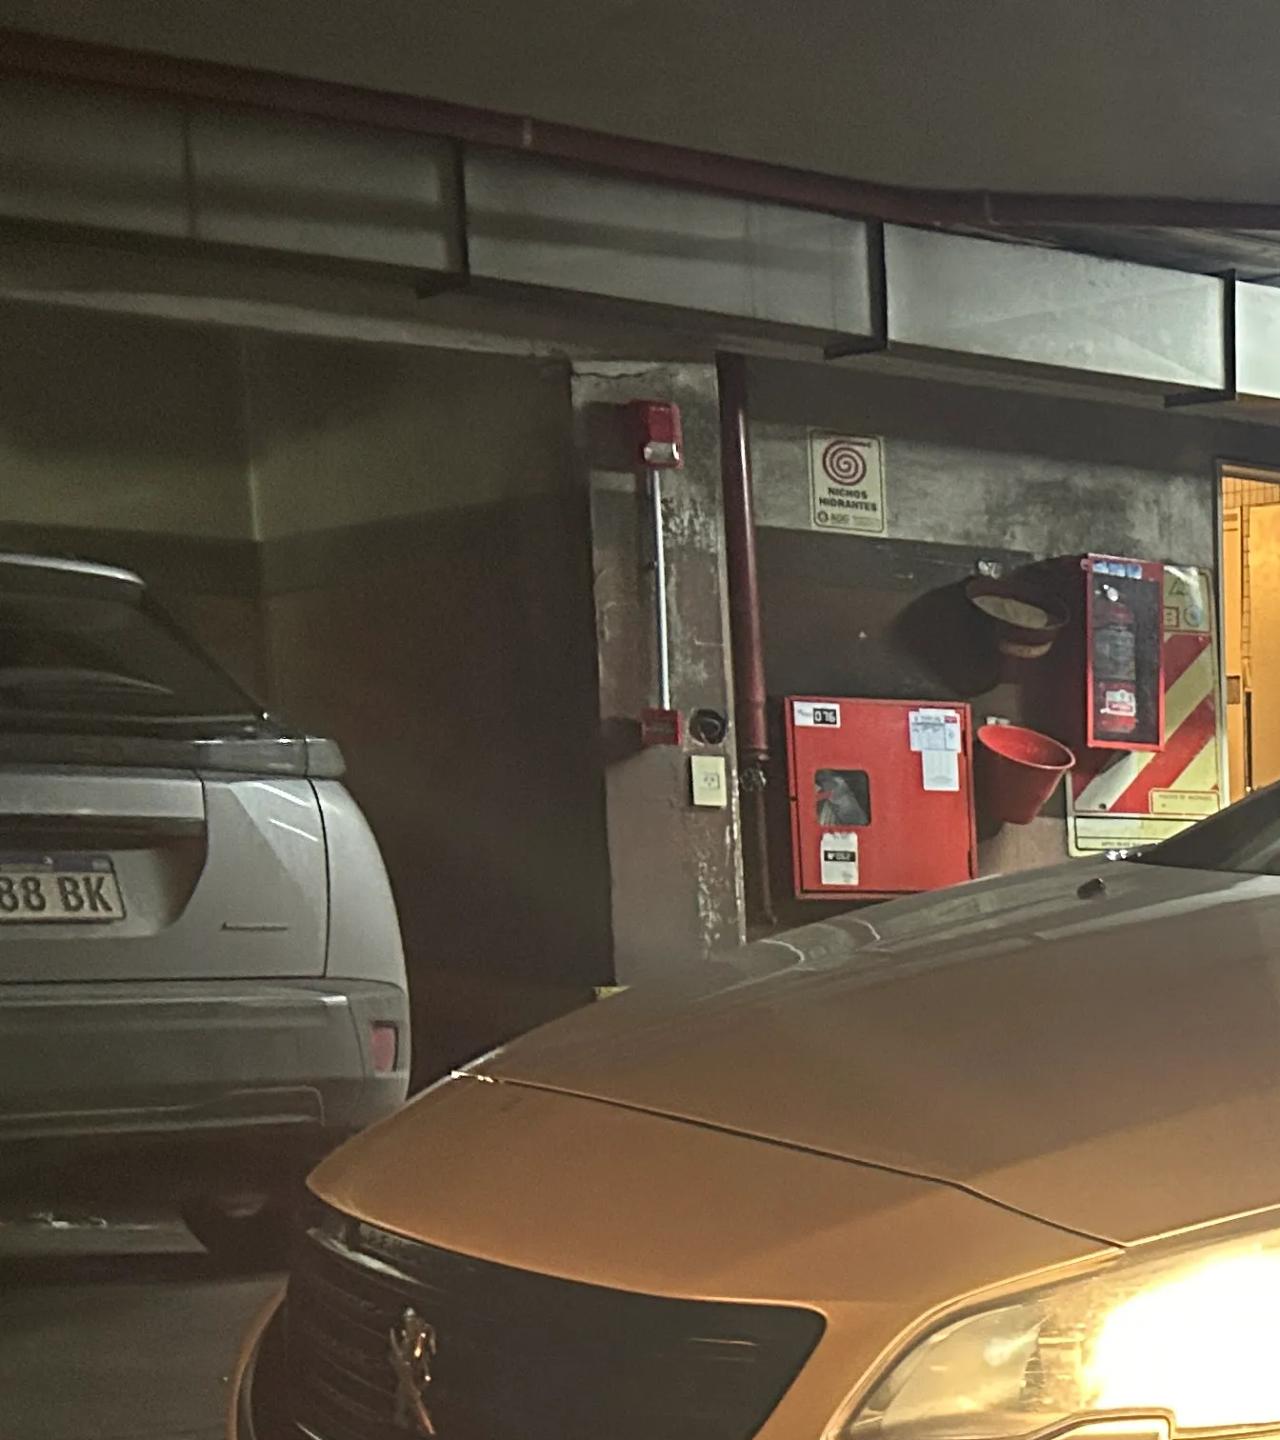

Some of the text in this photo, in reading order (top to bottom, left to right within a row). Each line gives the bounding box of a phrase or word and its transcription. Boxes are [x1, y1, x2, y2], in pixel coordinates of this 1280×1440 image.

[828, 487, 868, 500] NICHOS
[818, 497, 877, 511] HIDRANTES
[57, 876, 113, 912] BK
